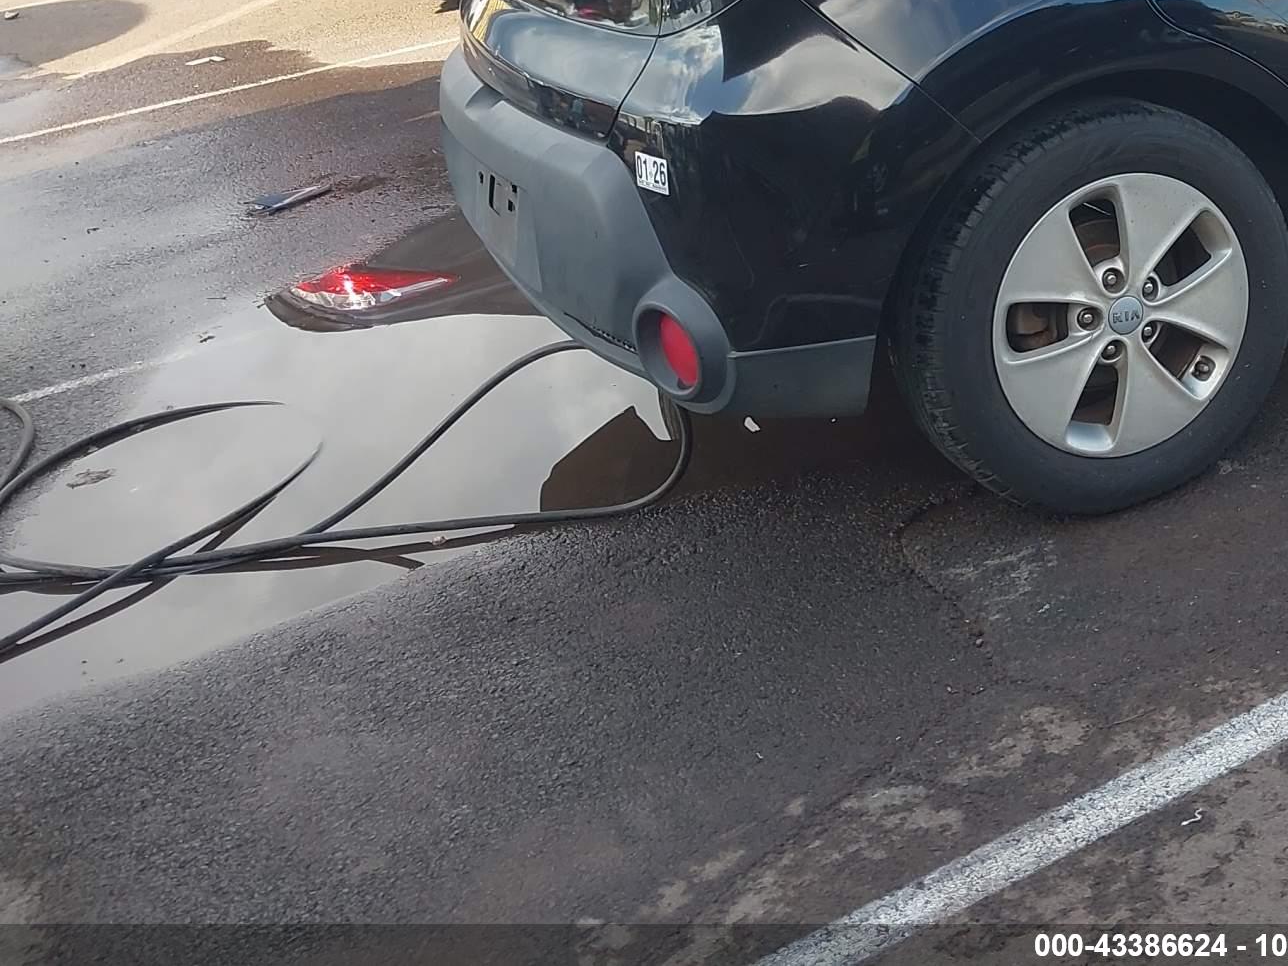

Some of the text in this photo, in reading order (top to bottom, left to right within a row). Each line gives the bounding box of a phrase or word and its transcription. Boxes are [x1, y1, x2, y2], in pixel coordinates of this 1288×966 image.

[636, 155, 666, 186] 01 26
[1113, 310, 1140, 324] KIA
